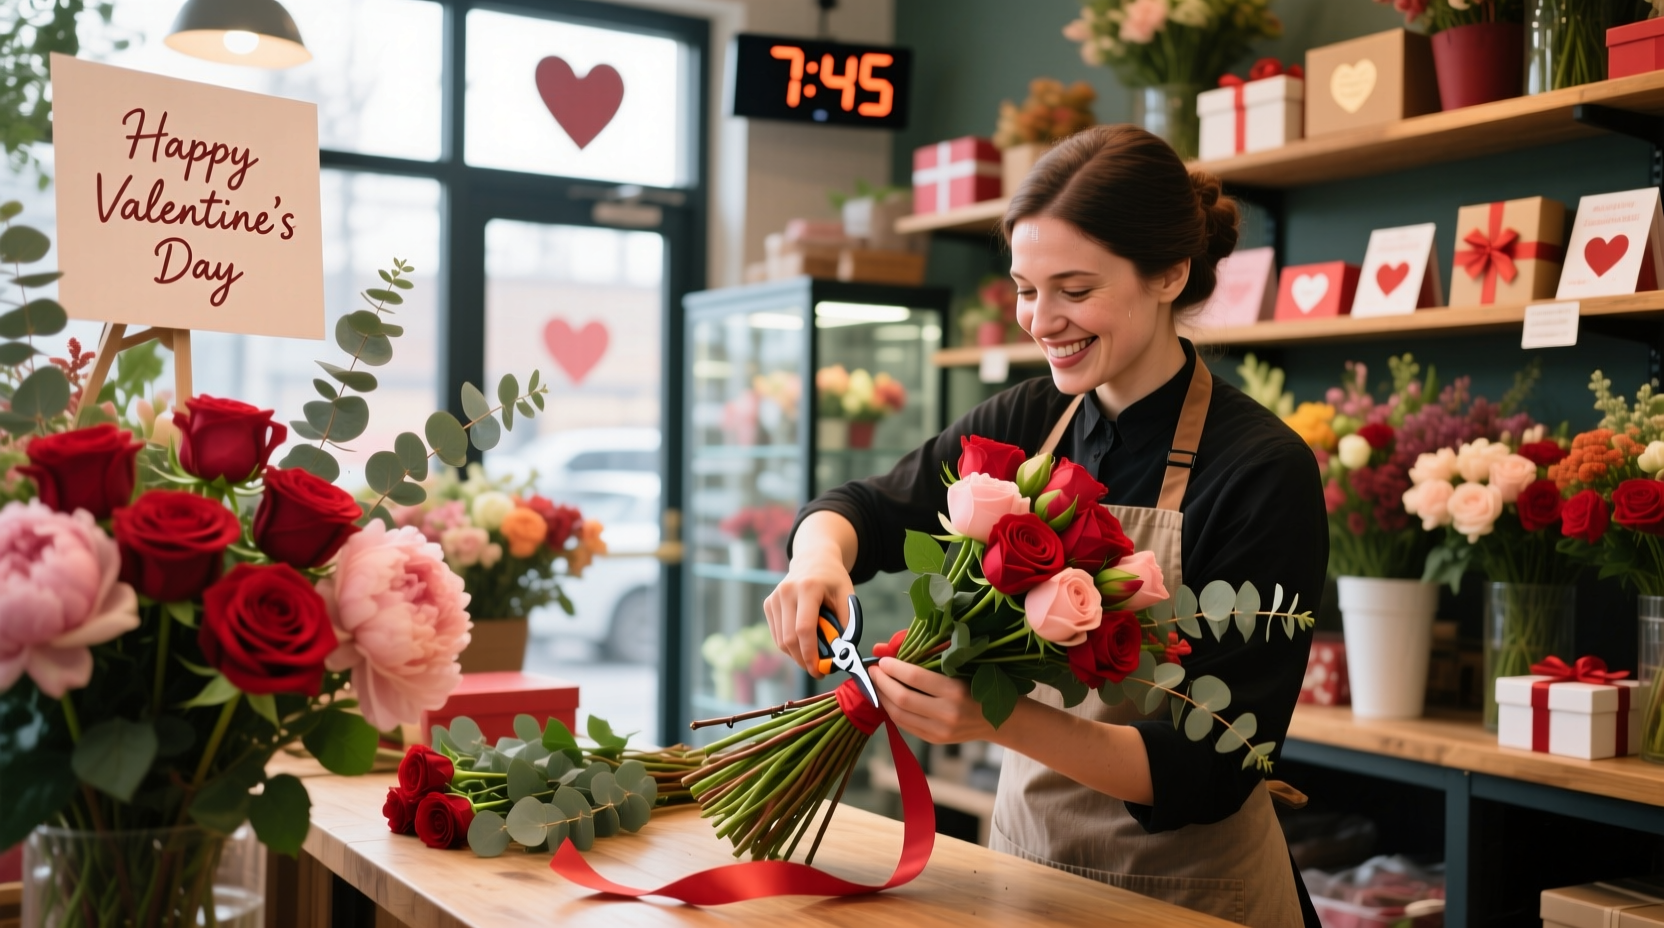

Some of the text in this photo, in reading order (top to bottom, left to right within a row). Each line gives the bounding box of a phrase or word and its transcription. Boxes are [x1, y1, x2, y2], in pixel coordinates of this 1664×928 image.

[770, 45, 894, 117] 7:45
[122, 107, 259, 191] Happy
[96, 172, 296, 240] Valentine's
[153, 237, 244, 307] Day
